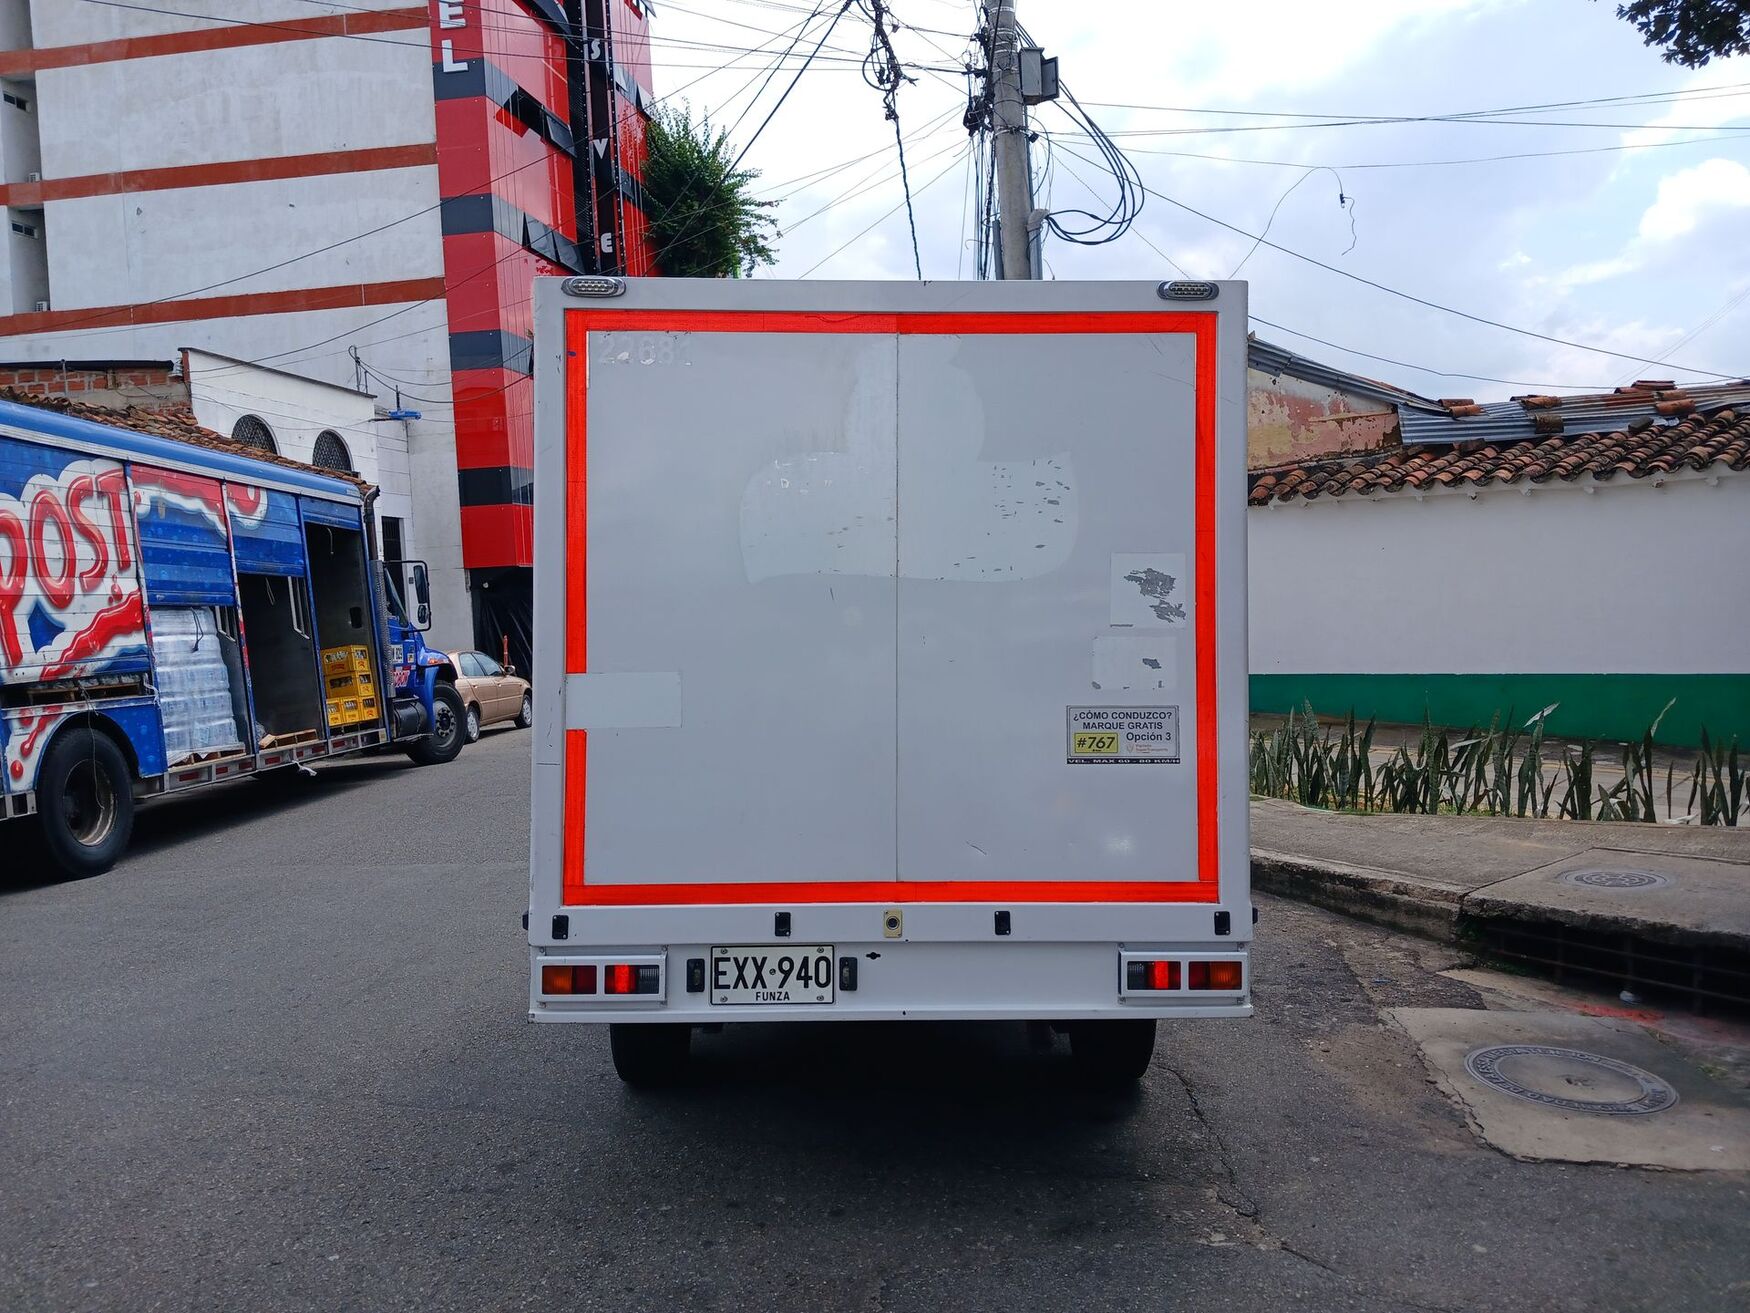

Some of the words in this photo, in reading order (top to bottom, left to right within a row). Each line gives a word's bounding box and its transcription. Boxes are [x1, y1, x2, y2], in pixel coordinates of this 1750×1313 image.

[1073, 710, 1109, 721] ¿CÓMO
[1111, 711, 1172, 720] CONDUZCO?
[1082, 722, 1125, 730] MARQUE
[1127, 722, 1163, 730] GRATIS
[1126, 732, 1163, 742] Opción
[1165, 732, 1172, 741] 3
[1077, 736, 1115, 749] #767
[755, 991, 790, 1001] FUNZA
